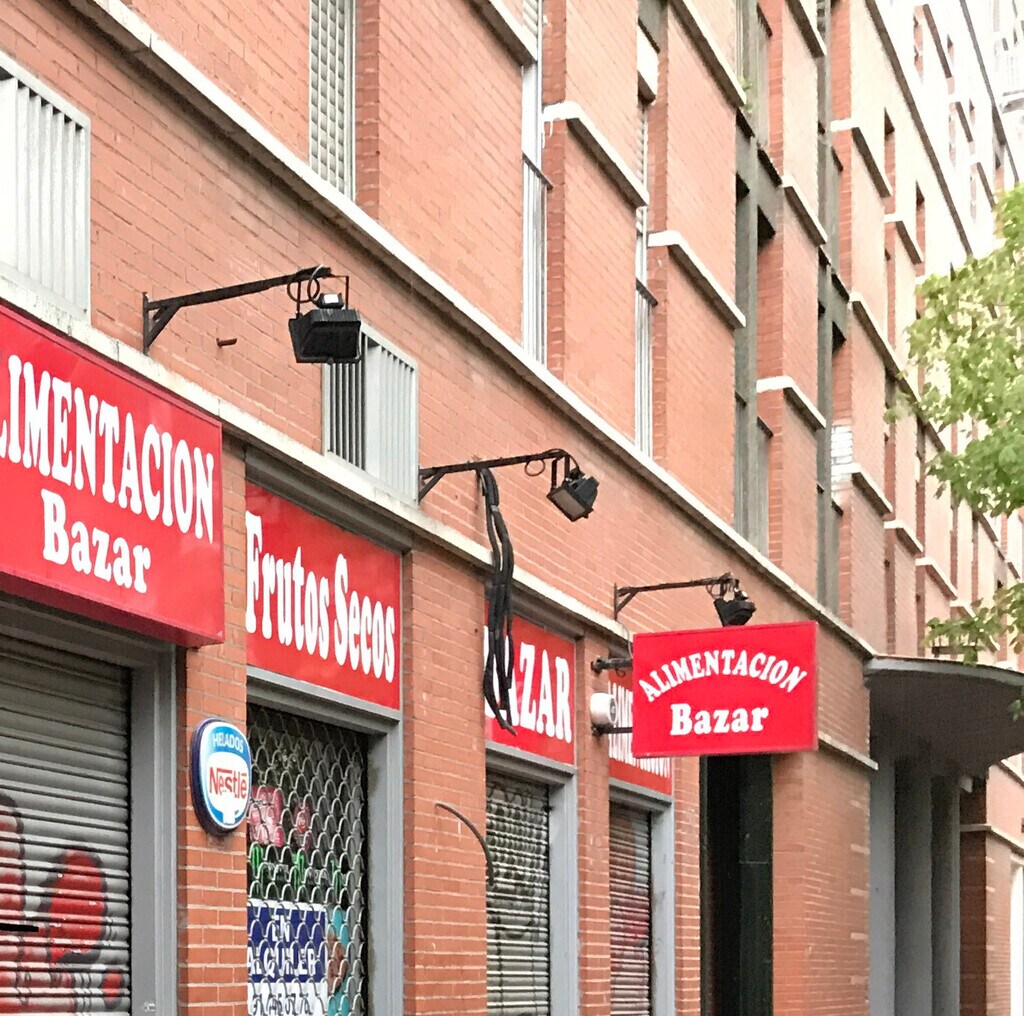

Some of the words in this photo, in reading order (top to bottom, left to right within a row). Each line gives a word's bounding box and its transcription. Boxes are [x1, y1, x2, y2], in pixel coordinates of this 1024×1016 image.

[41, 488, 152, 594] Bazar
[245, 510, 330, 660] Frutos
[333, 553, 395, 683] Secos
[638, 649, 808, 702] ALIMENTACION
[212, 732, 244, 754] HELADOS
[670, 703, 769, 736] Bazar
